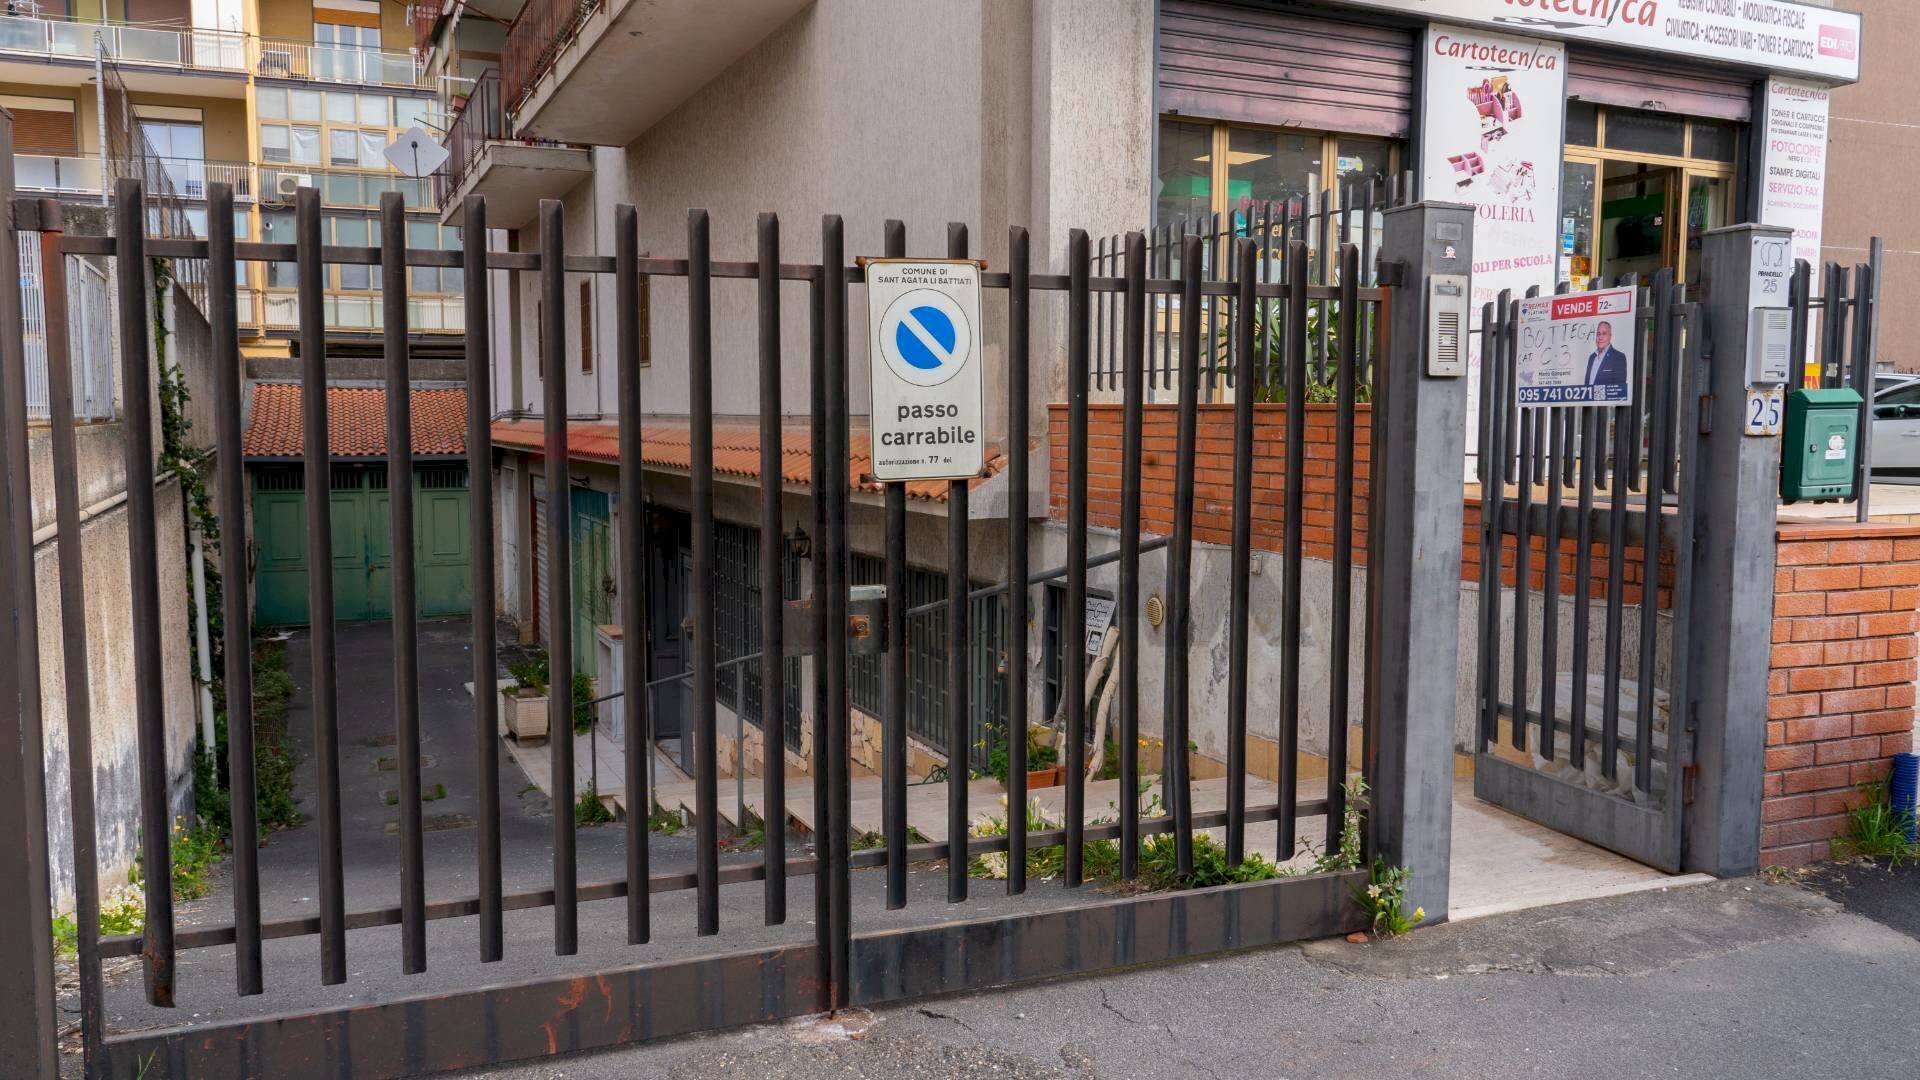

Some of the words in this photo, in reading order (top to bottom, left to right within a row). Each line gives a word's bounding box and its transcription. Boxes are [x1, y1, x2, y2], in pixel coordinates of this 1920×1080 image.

[1705, 0, 1736, 17] CONTABILI
[1743, 2, 1781, 24] MODULISTICA
[1782, 9, 1805, 29] FISCALE
[1665, 17, 1699, 40] CIVILISTICA
[1704, 24, 1738, 47] ACCESSORI
[1740, 30, 1753, 49] VARI
[1758, 33, 1776, 53] TONER
[1778, 37, 1781, 54] E
[1783, 38, 1814, 59] CARTUCCE
[1771, 109, 1790, 118] TONER
[1796, 112, 1825, 123] CARTUCCE
[1771, 140, 1822, 157] FOTOCOPIE
[1769, 166, 1793, 177] STAMPE
[1795, 169, 1821, 180] DIGITALI
[1768, 182, 1802, 195] SERVIZIO
[1805, 186, 1819, 196] FAX
[1492, 260, 1511, 271] PER
[1513, 255, 1553, 269] SCUOLA
[938, 277, 972, 285] BATTIATI
[1763, 279, 1777, 293] 25
[1557, 302, 1592, 315] VENDE
[1523, 322, 1596, 349] BOTTEGA
[1520, 388, 1540, 401] 095
[1543, 388, 1561, 400] 741
[1565, 387, 1593, 400] 0271
[897, 404, 958, 422] passo
[1751, 398, 1779, 426] 25
[881, 425, 975, 445] carrabile
